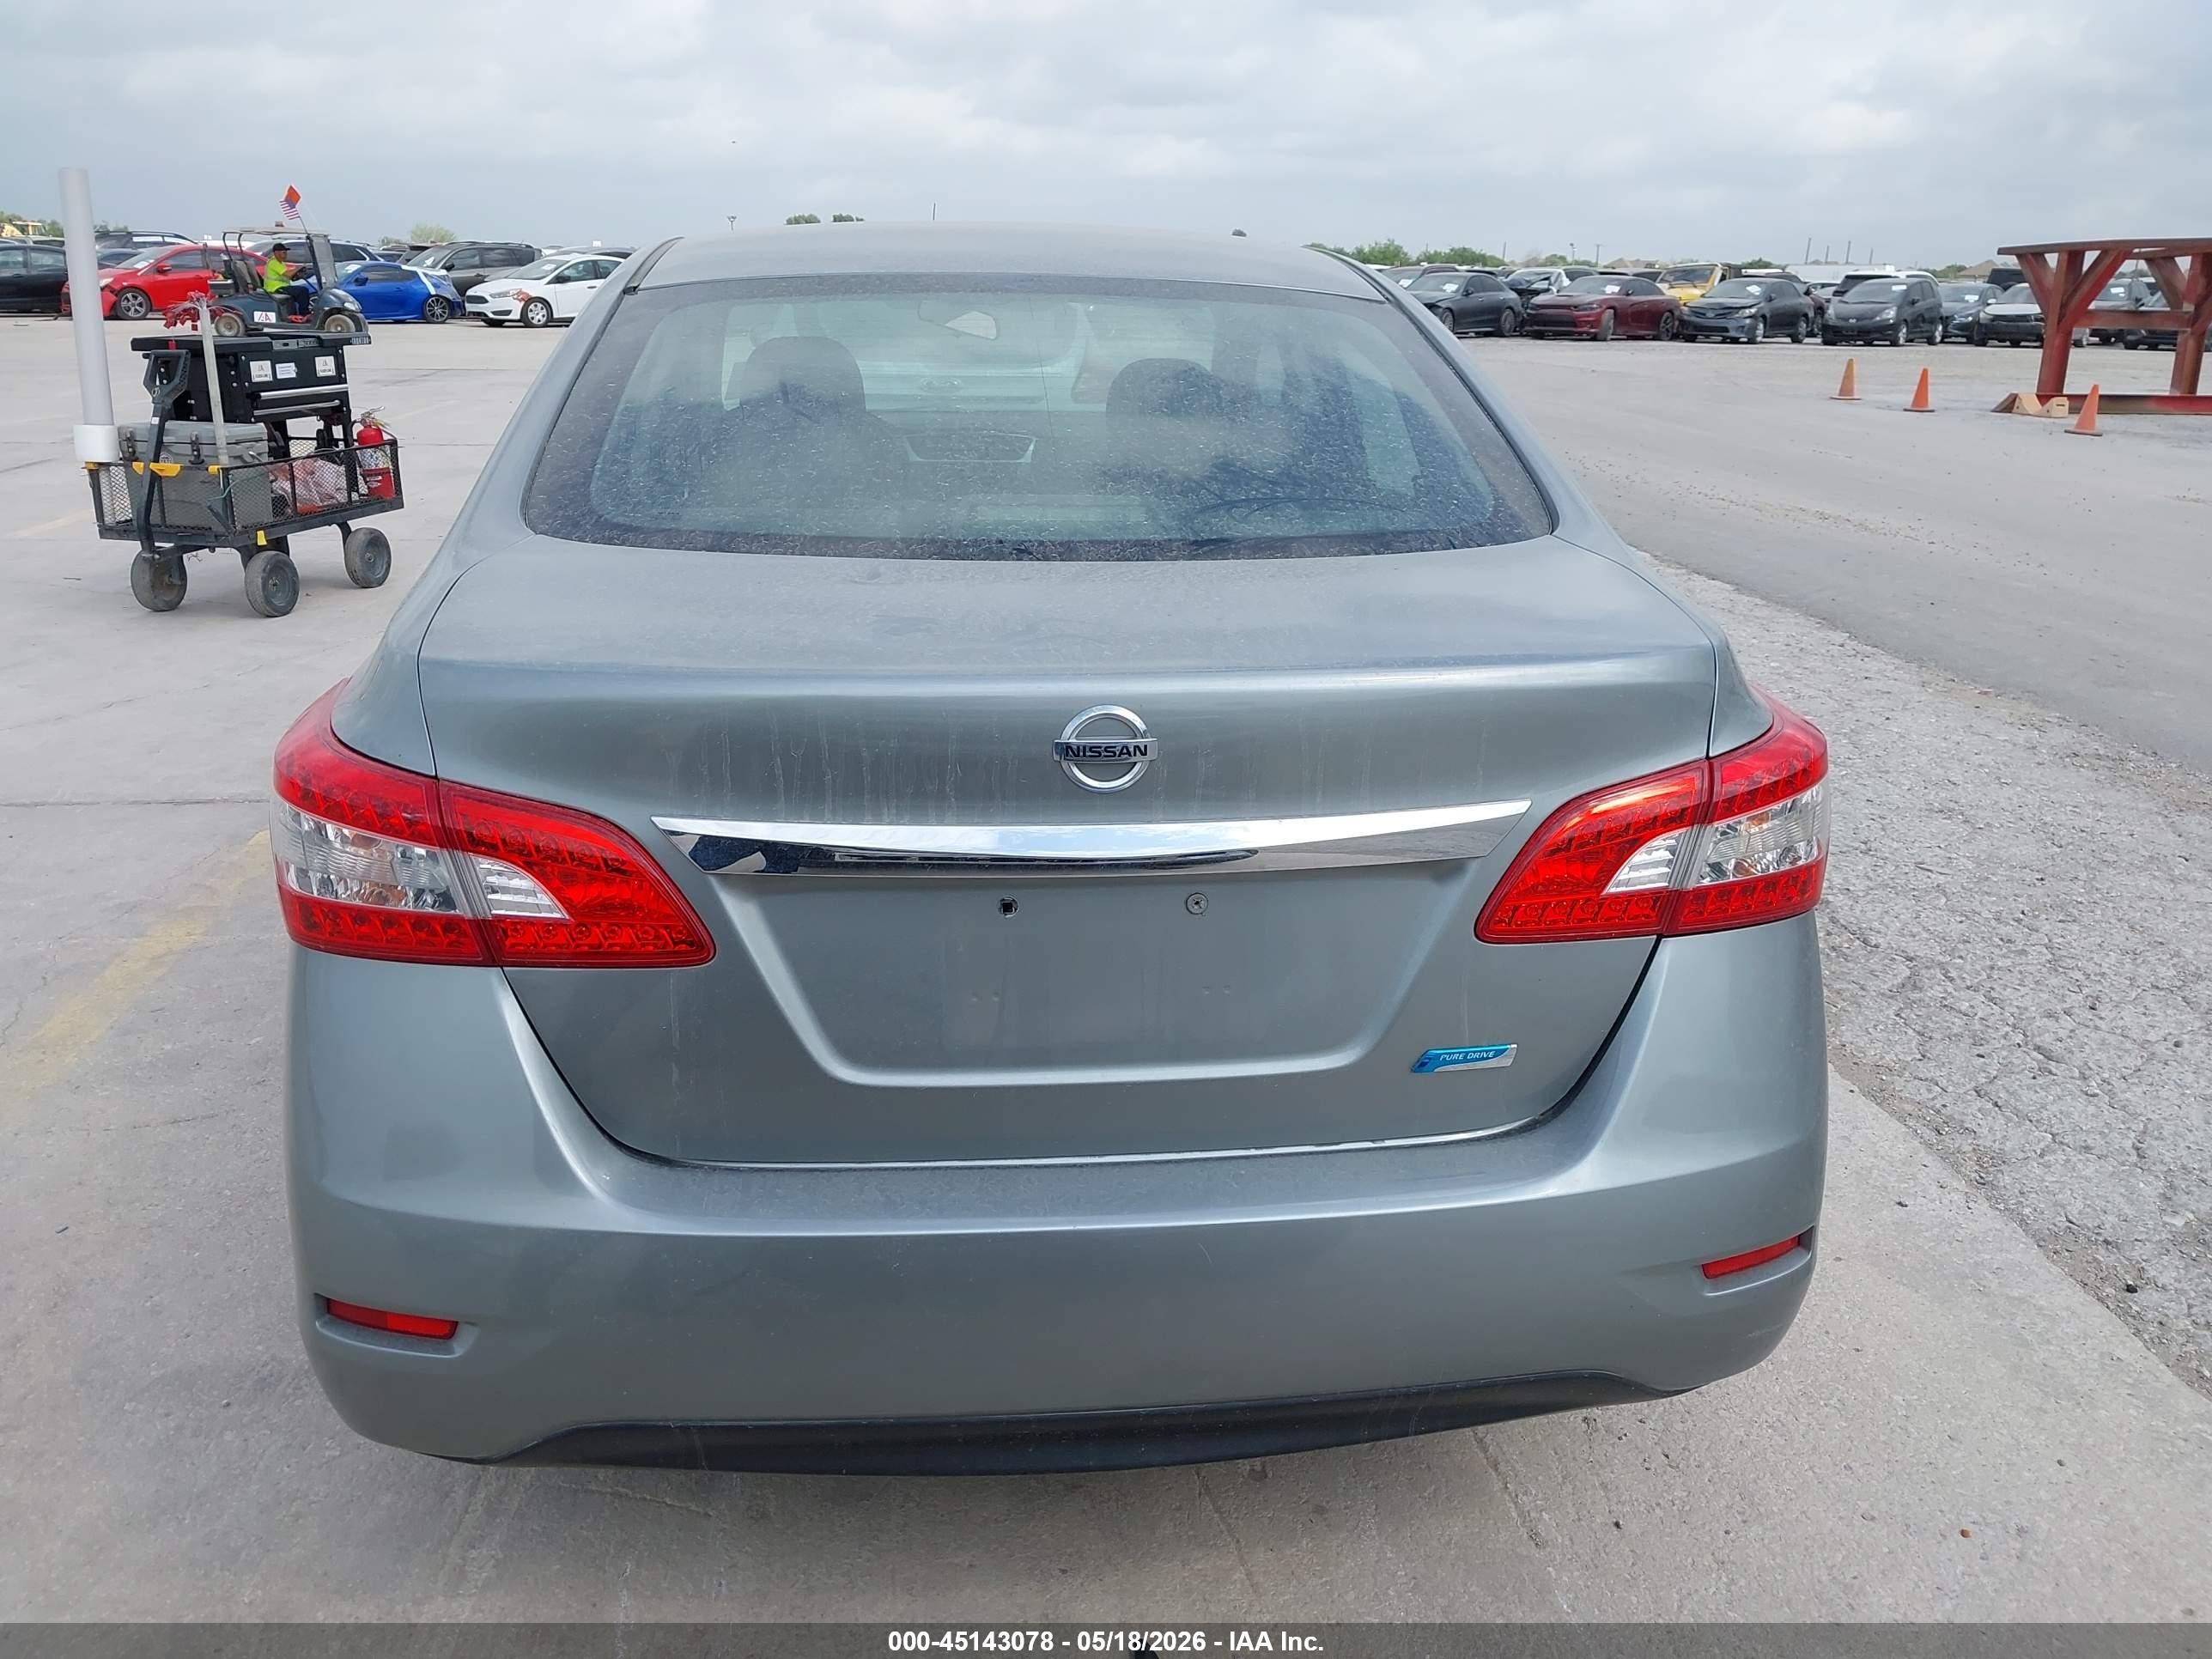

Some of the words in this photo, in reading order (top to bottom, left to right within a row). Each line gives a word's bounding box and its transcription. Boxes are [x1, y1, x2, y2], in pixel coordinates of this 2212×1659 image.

[1065, 744, 1148, 758] NISSAN
[1439, 1053, 1466, 1061] PURE
[1467, 1050, 1496, 1060] DRIVE
